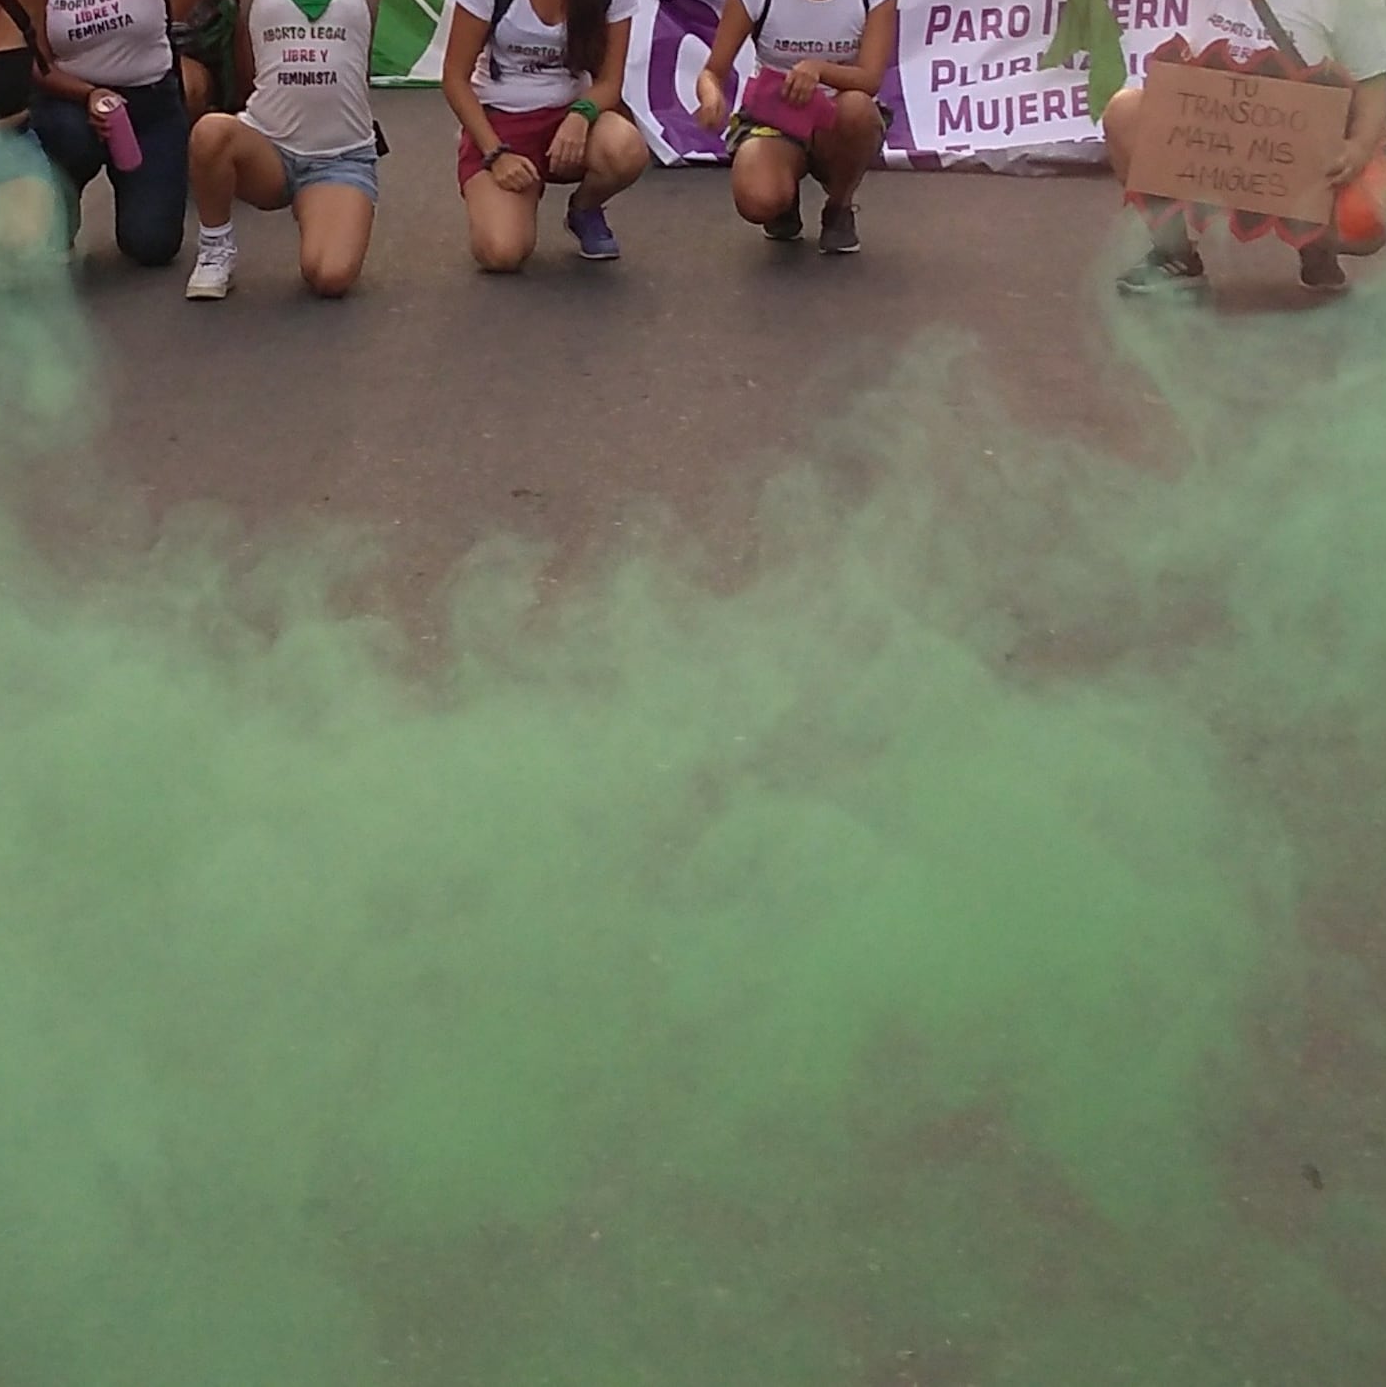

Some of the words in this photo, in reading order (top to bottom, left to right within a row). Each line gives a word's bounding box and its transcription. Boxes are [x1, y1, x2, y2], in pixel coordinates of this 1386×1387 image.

[75, 7, 109, 25] LIBRE
[111, 2, 120, 15] Y
[925, 4, 1031, 45] PARO
[67, 14, 134, 41] FEMINISTA
[263, 27, 306, 43] ABORTO
[311, 26, 347, 41] LEGAL
[282, 49, 316, 62] LIBRE
[320, 49, 329, 62] Y
[774, 39, 824, 53] ABORTO
[277, 71, 338, 86] FEMINISTA
[1227, 77, 1259, 98] TU
[1176, 92, 1308, 132] TRANSODIO
[1167, 125, 1235, 156] MATA
[1248, 137, 1295, 165] MIS
[1175, 164, 1288, 198] AMIGUES
